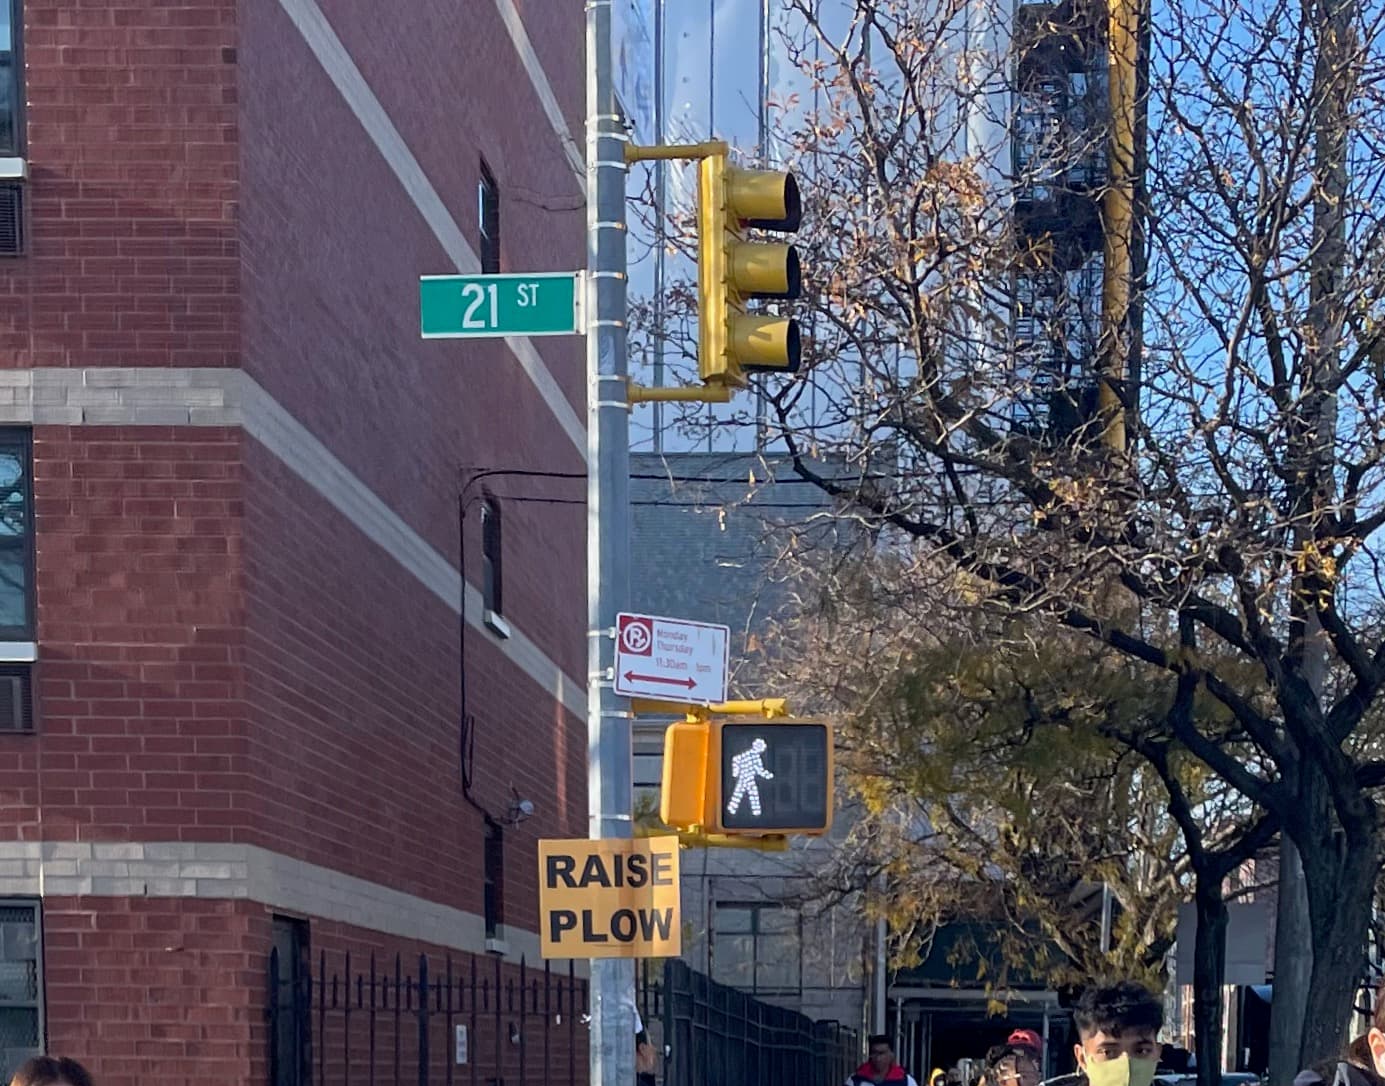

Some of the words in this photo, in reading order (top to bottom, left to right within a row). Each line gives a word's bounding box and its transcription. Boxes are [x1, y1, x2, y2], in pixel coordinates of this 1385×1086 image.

[461, 282, 499, 329] 21
[516, 283, 540, 307] ST
[546, 853, 673, 889] RAISE
[549, 908, 674, 943] PLOW
